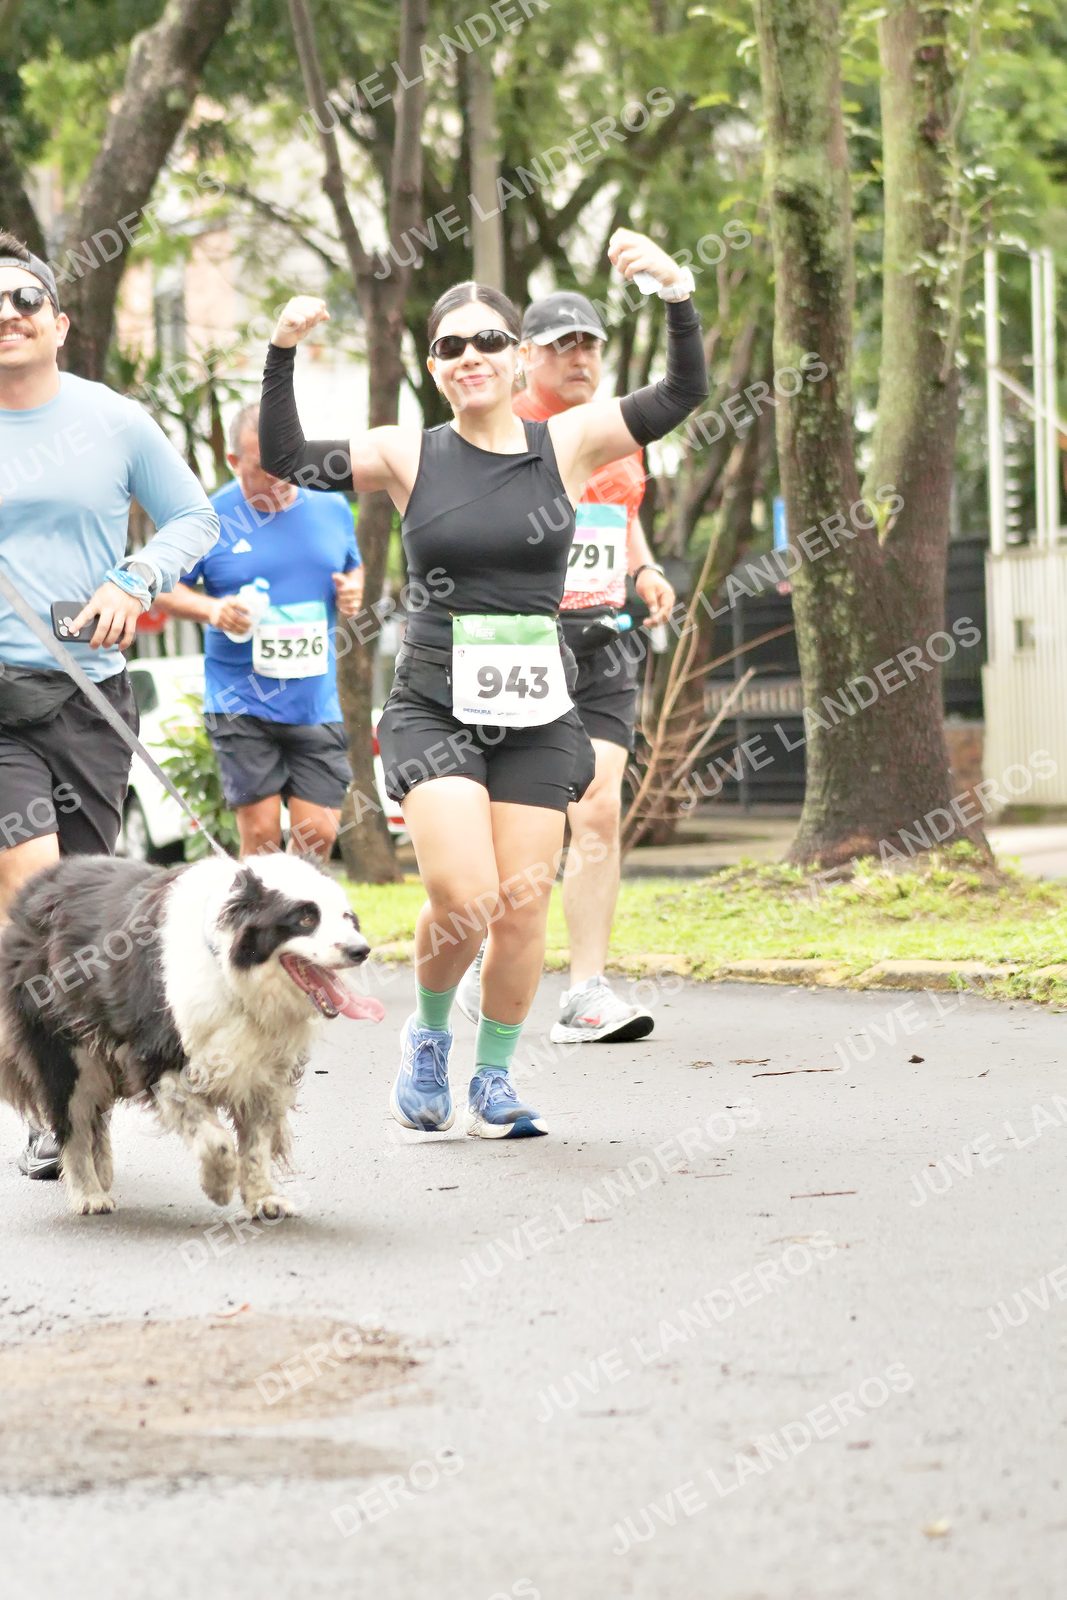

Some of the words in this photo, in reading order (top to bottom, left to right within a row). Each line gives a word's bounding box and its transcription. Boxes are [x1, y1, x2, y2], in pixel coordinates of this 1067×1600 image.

[568, 543, 615, 569] 791
[261, 636, 323, 658] 5326
[477, 665, 549, 699] 943
